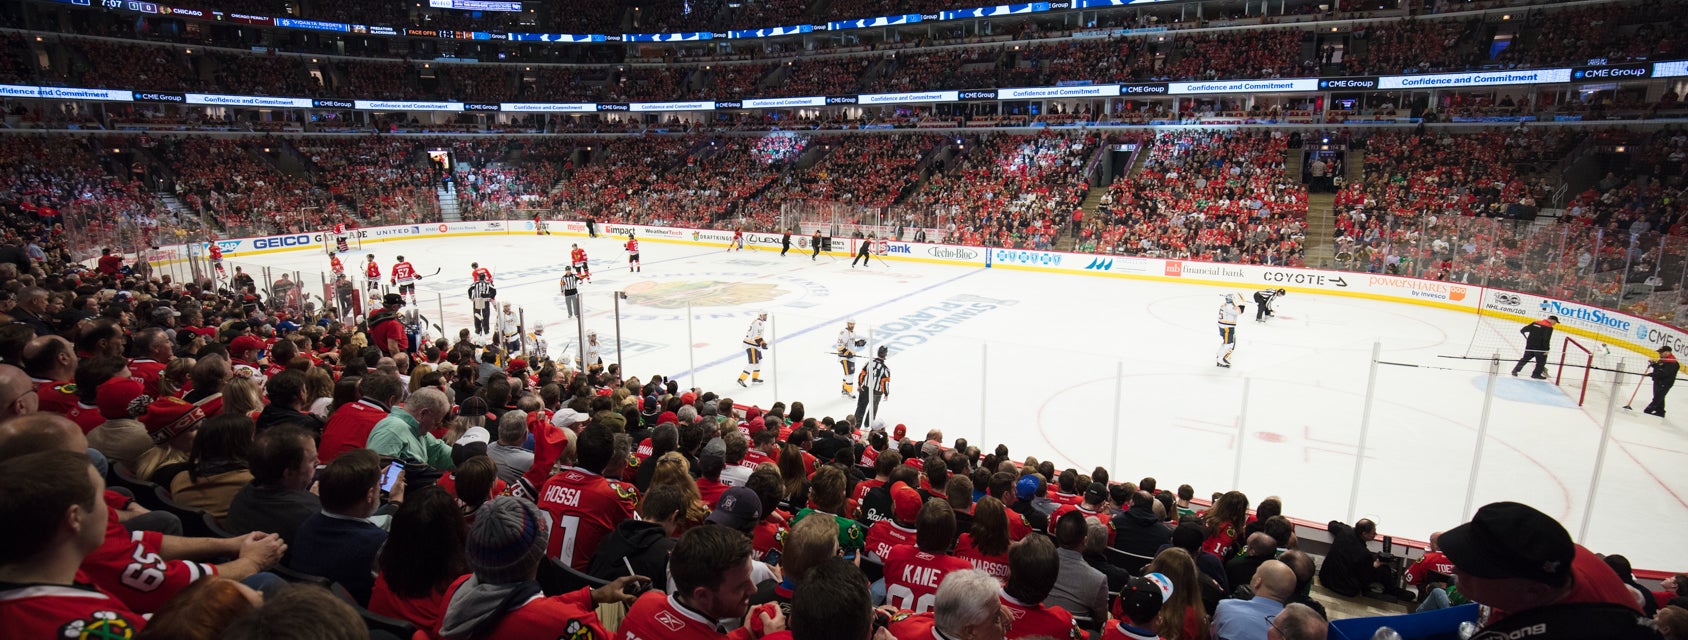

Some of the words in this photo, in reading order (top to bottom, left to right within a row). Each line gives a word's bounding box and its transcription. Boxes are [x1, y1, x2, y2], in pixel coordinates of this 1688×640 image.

[173, 8, 203, 16] CHICAGO
[1584, 69, 1609, 78] CME
[1610, 67, 1646, 78] Group
[1328, 80, 1347, 88] CME
[1347, 79, 1373, 89] Group
[1401, 77, 1452, 86] Confidence
[1454, 76, 1472, 85] and
[1473, 73, 1538, 83] Commitment
[1128, 85, 1143, 93] CME
[1143, 85, 1165, 94] Group
[1187, 83, 1227, 92] Confidence
[1228, 83, 1243, 91] and
[1244, 81, 1293, 91] Commitment
[55, 89, 109, 98] Commitment
[909, 93, 942, 101] Commitment
[964, 91, 977, 99] CME
[977, 91, 995, 100] Group
[1012, 89, 1047, 97] Confidence
[1048, 88, 1059, 96] and
[1060, 87, 1100, 96] Commitment
[159, 94, 182, 102] Group
[204, 96, 241, 104] Confidence
[255, 98, 294, 106] Commitment
[376, 228, 410, 236] UNITED
[567, 223, 586, 232] meijer
[610, 226, 635, 236] impact
[645, 228, 683, 236] WeatherTech
[220, 242, 237, 252] SAP
[253, 234, 310, 250] GEICO
[887, 243, 911, 254] bank
[932, 245, 974, 260] Techo-Bloc
[397, 267, 410, 278] 57
[1166, 264, 1181, 274] mb
[1182, 264, 1220, 276] financial
[1221, 267, 1245, 278] bank
[1264, 271, 1325, 286] COYOTE
[1549, 300, 1631, 332] NorthShore
[1648, 329, 1674, 346] CME
[544, 484, 582, 508] HOSSA
[120, 544, 168, 592] 65
[902, 564, 941, 588] KANE
